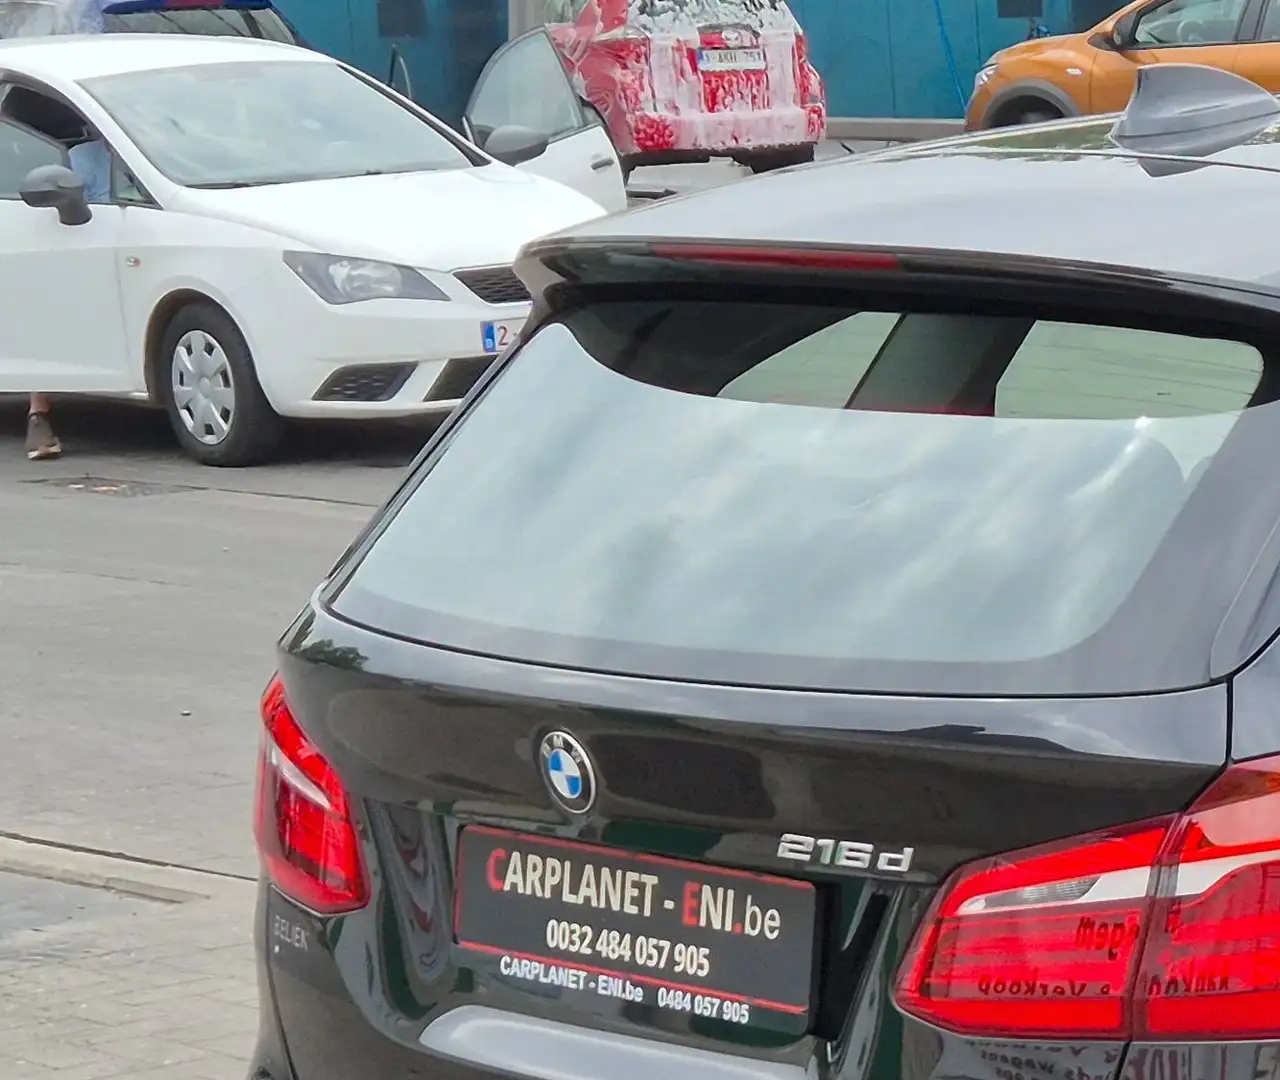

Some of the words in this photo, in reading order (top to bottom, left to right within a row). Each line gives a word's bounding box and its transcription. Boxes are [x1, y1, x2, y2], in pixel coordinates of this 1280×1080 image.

[486, 848, 659, 917] CARPLANET
[682, 881, 781, 940] ENI.be
[546, 918, 593, 955] 0032
[595, 928, 632, 962] 484
[635, 935, 671, 969] 057
[673, 942, 711, 977] 905
[500, 955, 588, 990] CARPLANET
[597, 973, 644, 1003] ENI.be
[657, 986, 692, 1014] 0484
[693, 995, 724, 1019] 057
[722, 1001, 750, 1025] 905
